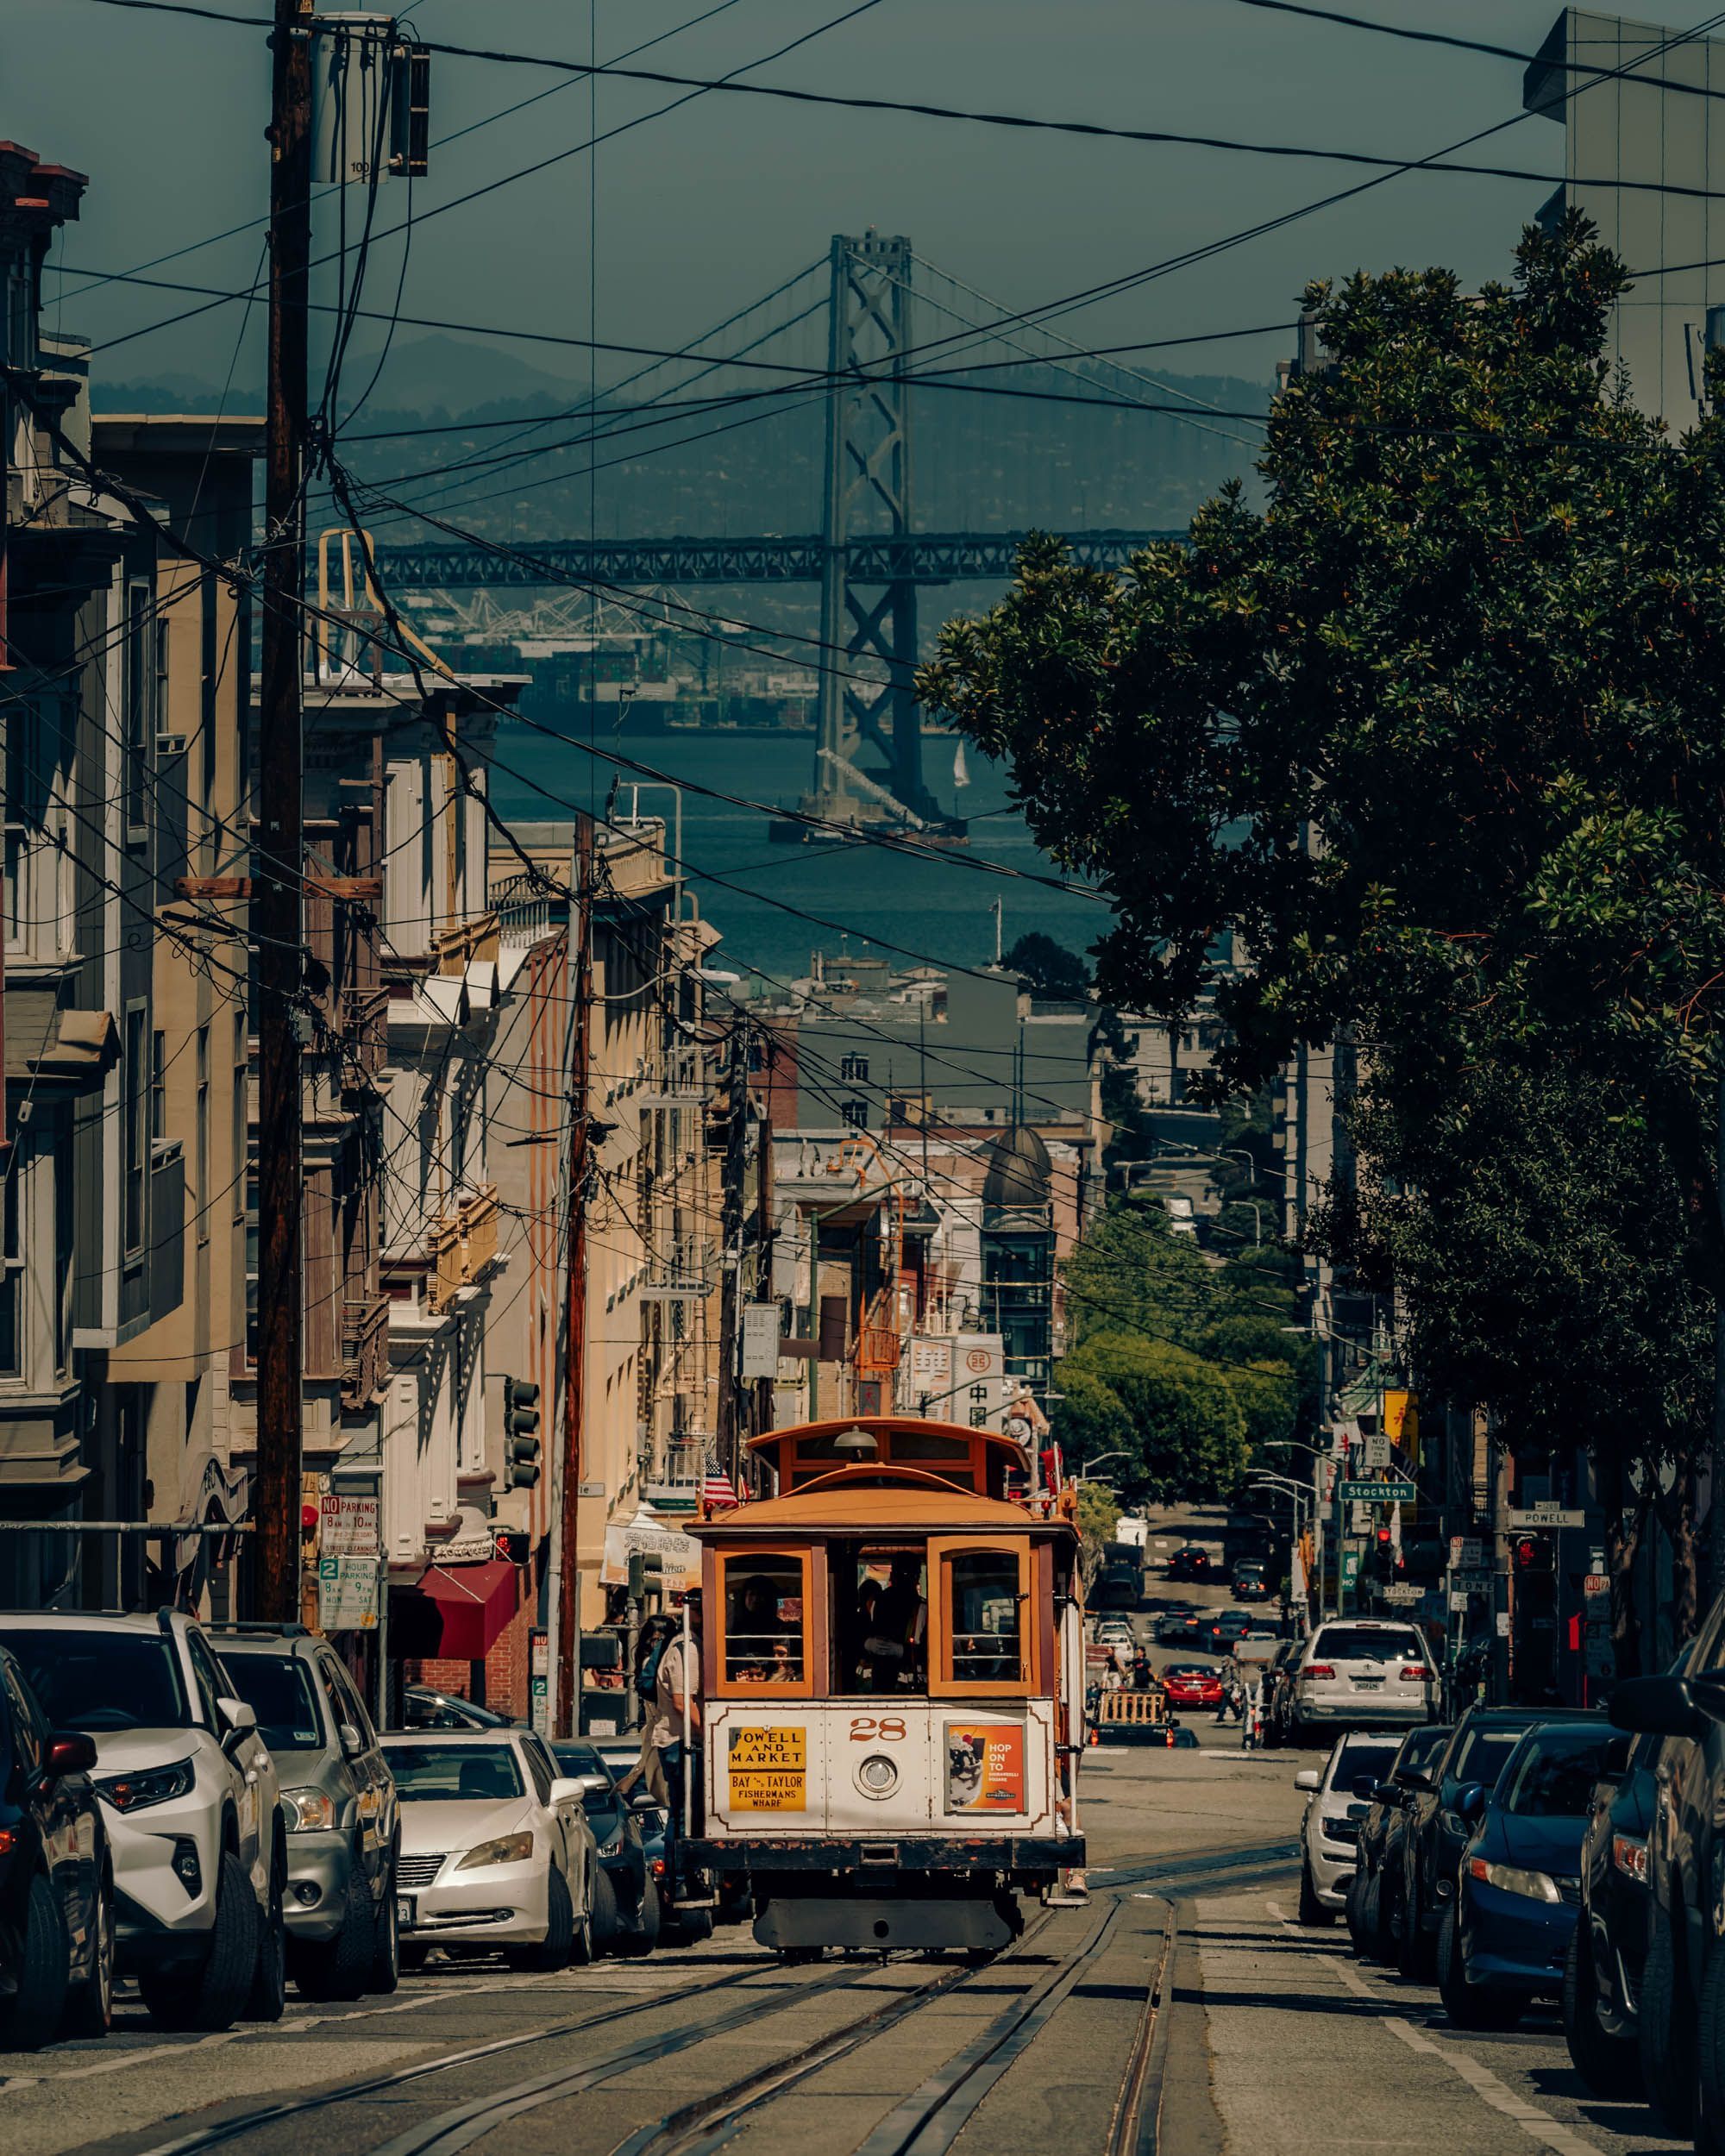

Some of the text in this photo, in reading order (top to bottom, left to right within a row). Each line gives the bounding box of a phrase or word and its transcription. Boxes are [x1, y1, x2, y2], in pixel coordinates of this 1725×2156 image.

[351, 162, 369, 172] 100
[1348, 1486, 1408, 1497] Stockton
[323, 1498, 375, 1514] NO PARKING
[327, 1516, 334, 1527] 8
[354, 1517, 364, 1527] 10
[1526, 1514, 1569, 1523] POWELL
[1452, 1539, 1462, 1547] NO
[323, 1562, 336, 1576] 2
[325, 1582, 331, 1593] 8
[1586, 1576, 1600, 1590] NO
[536, 1683, 546, 1695] 2
[850, 1718, 906, 1741] 28
[735, 1733, 801, 1743] POWELL
[988, 1744, 1012, 1752] HOP
[731, 1752, 802, 1762] MARKET
[988, 1753, 1006, 1762] ON
[732, 1777, 750, 1788] BAY
[767, 1777, 802, 1788] TAYLOR
